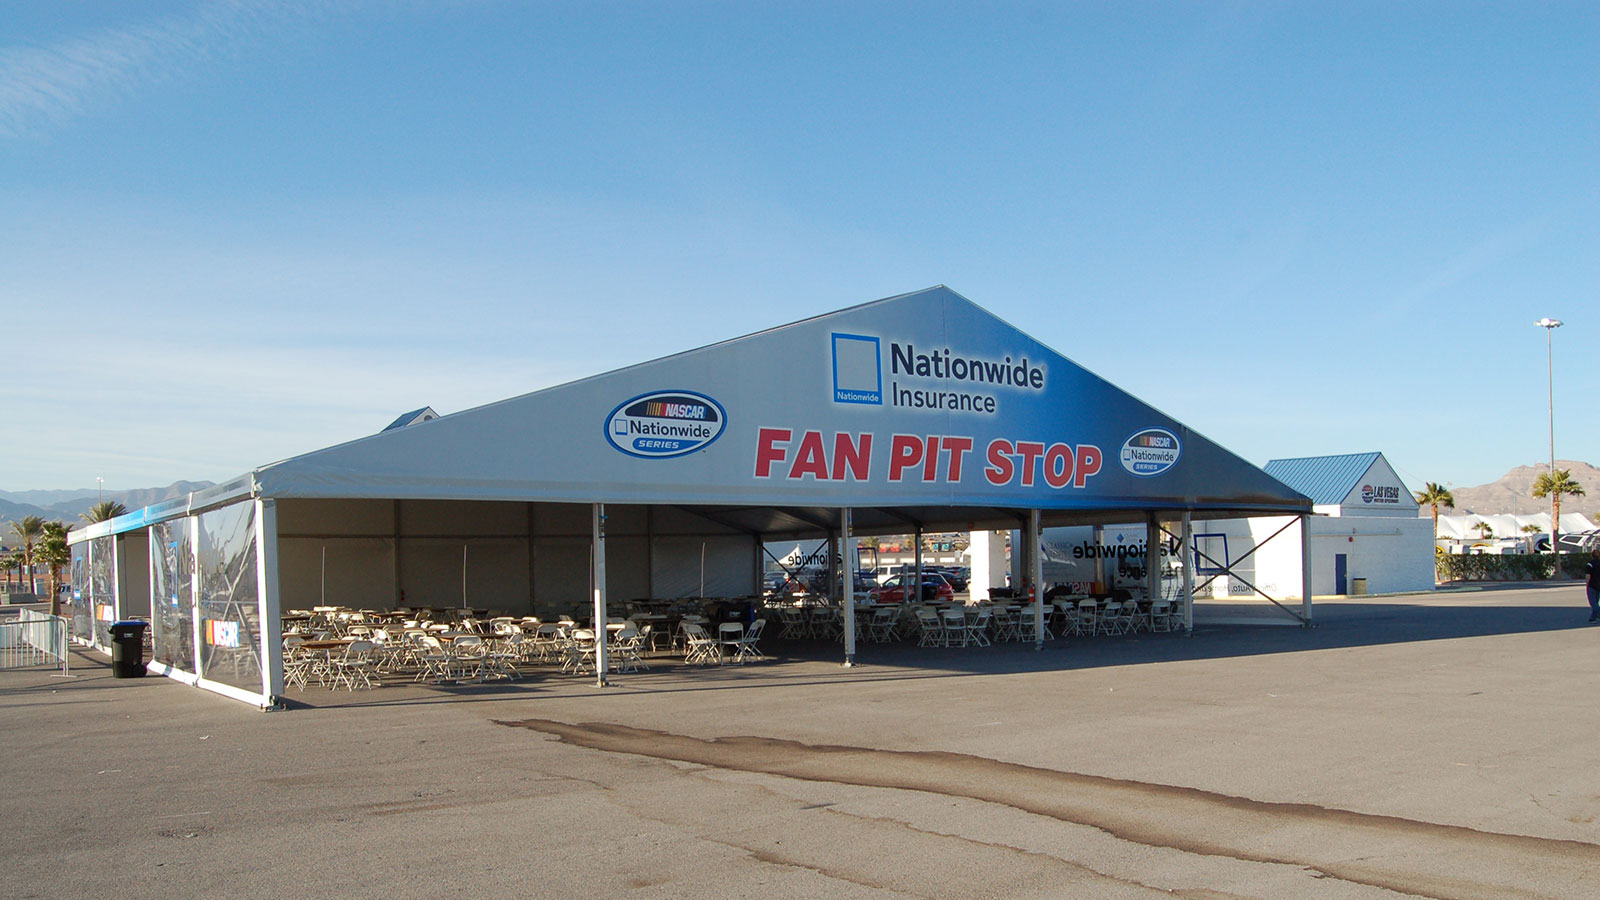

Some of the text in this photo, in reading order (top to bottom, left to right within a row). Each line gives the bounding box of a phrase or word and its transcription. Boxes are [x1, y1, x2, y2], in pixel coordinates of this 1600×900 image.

[891, 342, 1044, 389] Nationwide
[837, 391, 879, 402] Nationwide
[892, 381, 996, 414] Insurance
[665, 403, 705, 419] NASCAR
[630, 420, 711, 437] Nationwide
[638, 439, 680, 449] SERIES
[1150, 436, 1170, 448] NASCAR
[753, 426, 1103, 489] FAN PIT STOP
[1131, 449, 1174, 461] Nationwide
[1373, 486, 1399, 498] LAS VEGAS
